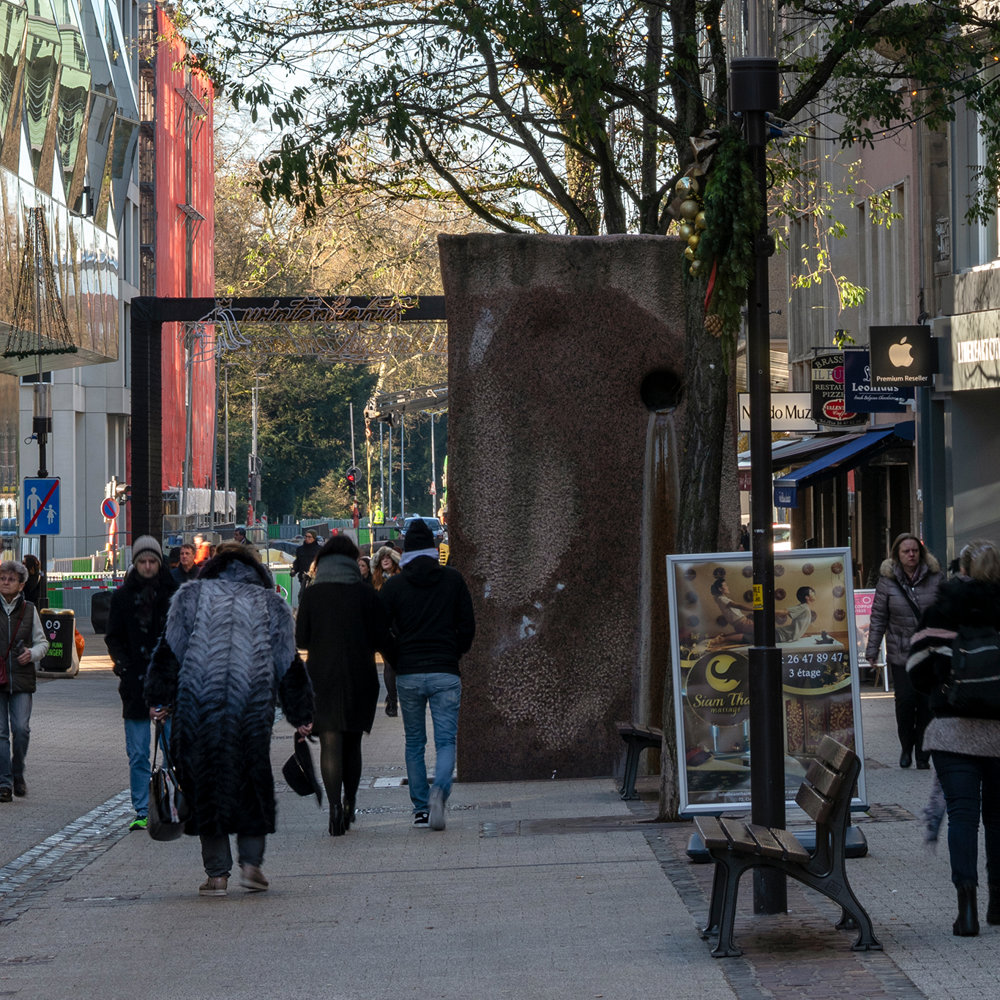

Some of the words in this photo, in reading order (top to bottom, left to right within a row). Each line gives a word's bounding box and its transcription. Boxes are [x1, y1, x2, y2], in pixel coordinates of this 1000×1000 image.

[815, 355, 844, 368] BRASS
[814, 370, 824, 379] IL
[827, 370, 843, 379] FU
[742, 404, 783, 419] Ndo
[785, 404, 812, 420] Muz
[787, 654, 799, 664] 26
[802, 653, 813, 664] 47
[816, 653, 828, 663] 89
[831, 652, 843, 662] 47
[789, 668, 795, 678] 3
[797, 667, 821, 679] étage
[693, 694, 724, 708] Siam
[727, 691, 750, 705] Tha
